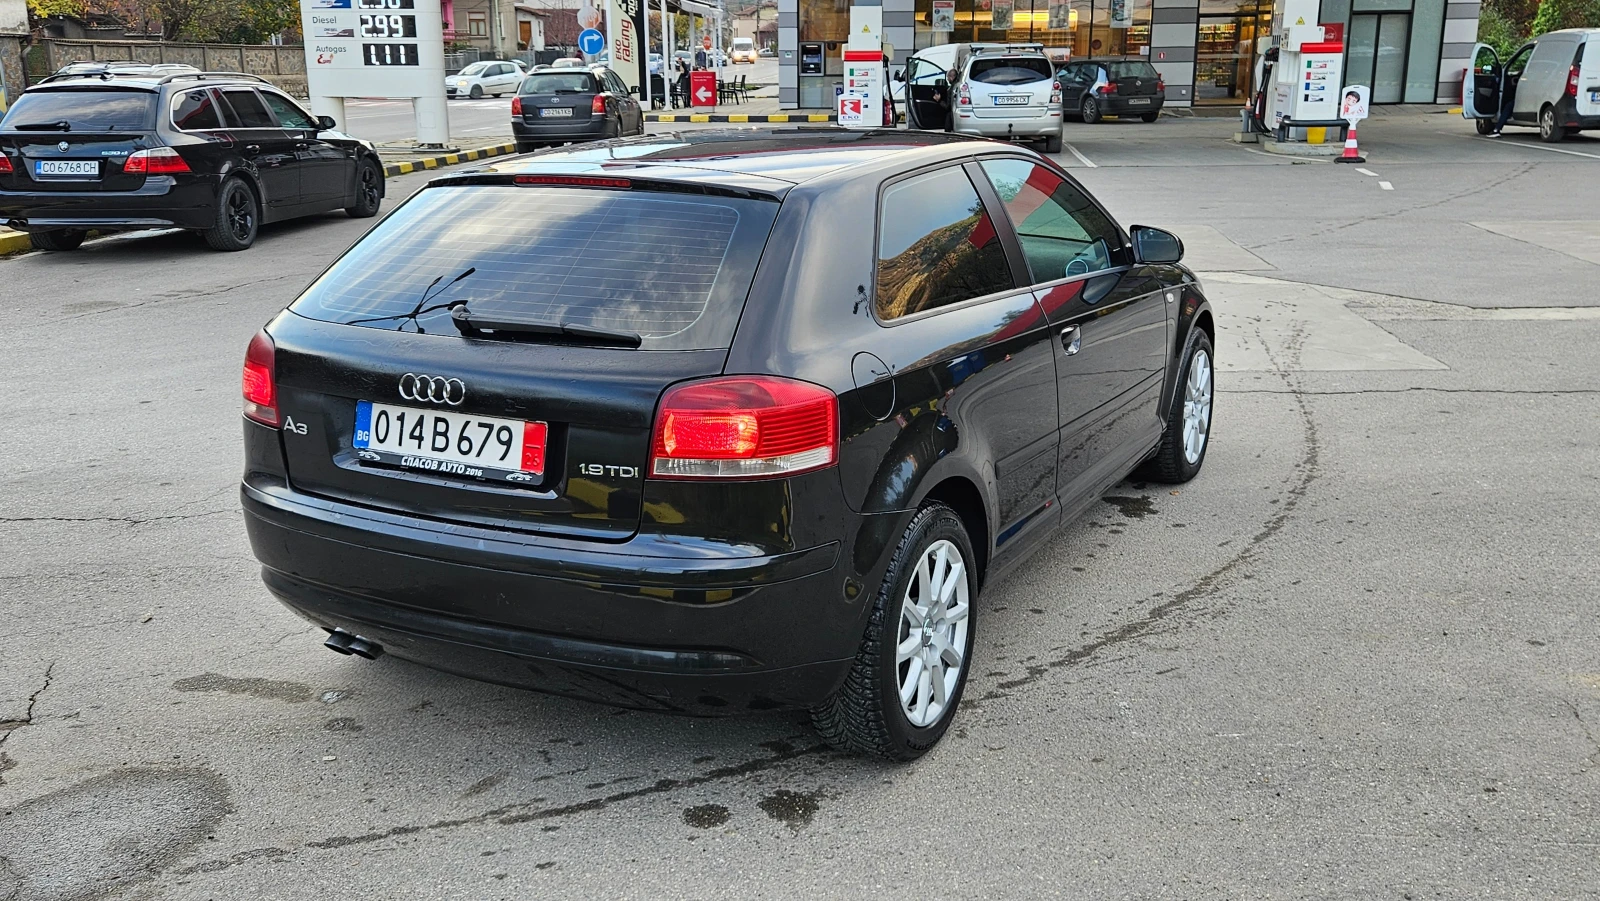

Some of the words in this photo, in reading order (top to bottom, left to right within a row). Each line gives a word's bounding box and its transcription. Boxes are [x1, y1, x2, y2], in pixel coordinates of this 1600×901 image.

[312, 16, 337, 24] Diesel
[361, 15, 404, 37] 2.99
[621, 19, 632, 63] racing
[316, 45, 347, 54] Autogas
[42, 163, 56, 173] CO
[57, 162, 82, 173] 6768
[83, 162, 97, 173] CH
[283, 415, 308, 435] A3
[356, 430, 370, 442] BG
[401, 456, 437, 471] СПАСОВ
[439, 461, 465, 475] АУТО
[466, 467, 483, 477] 2016
[579, 463, 604, 476] 1.9
[605, 465, 639, 479] TDI
